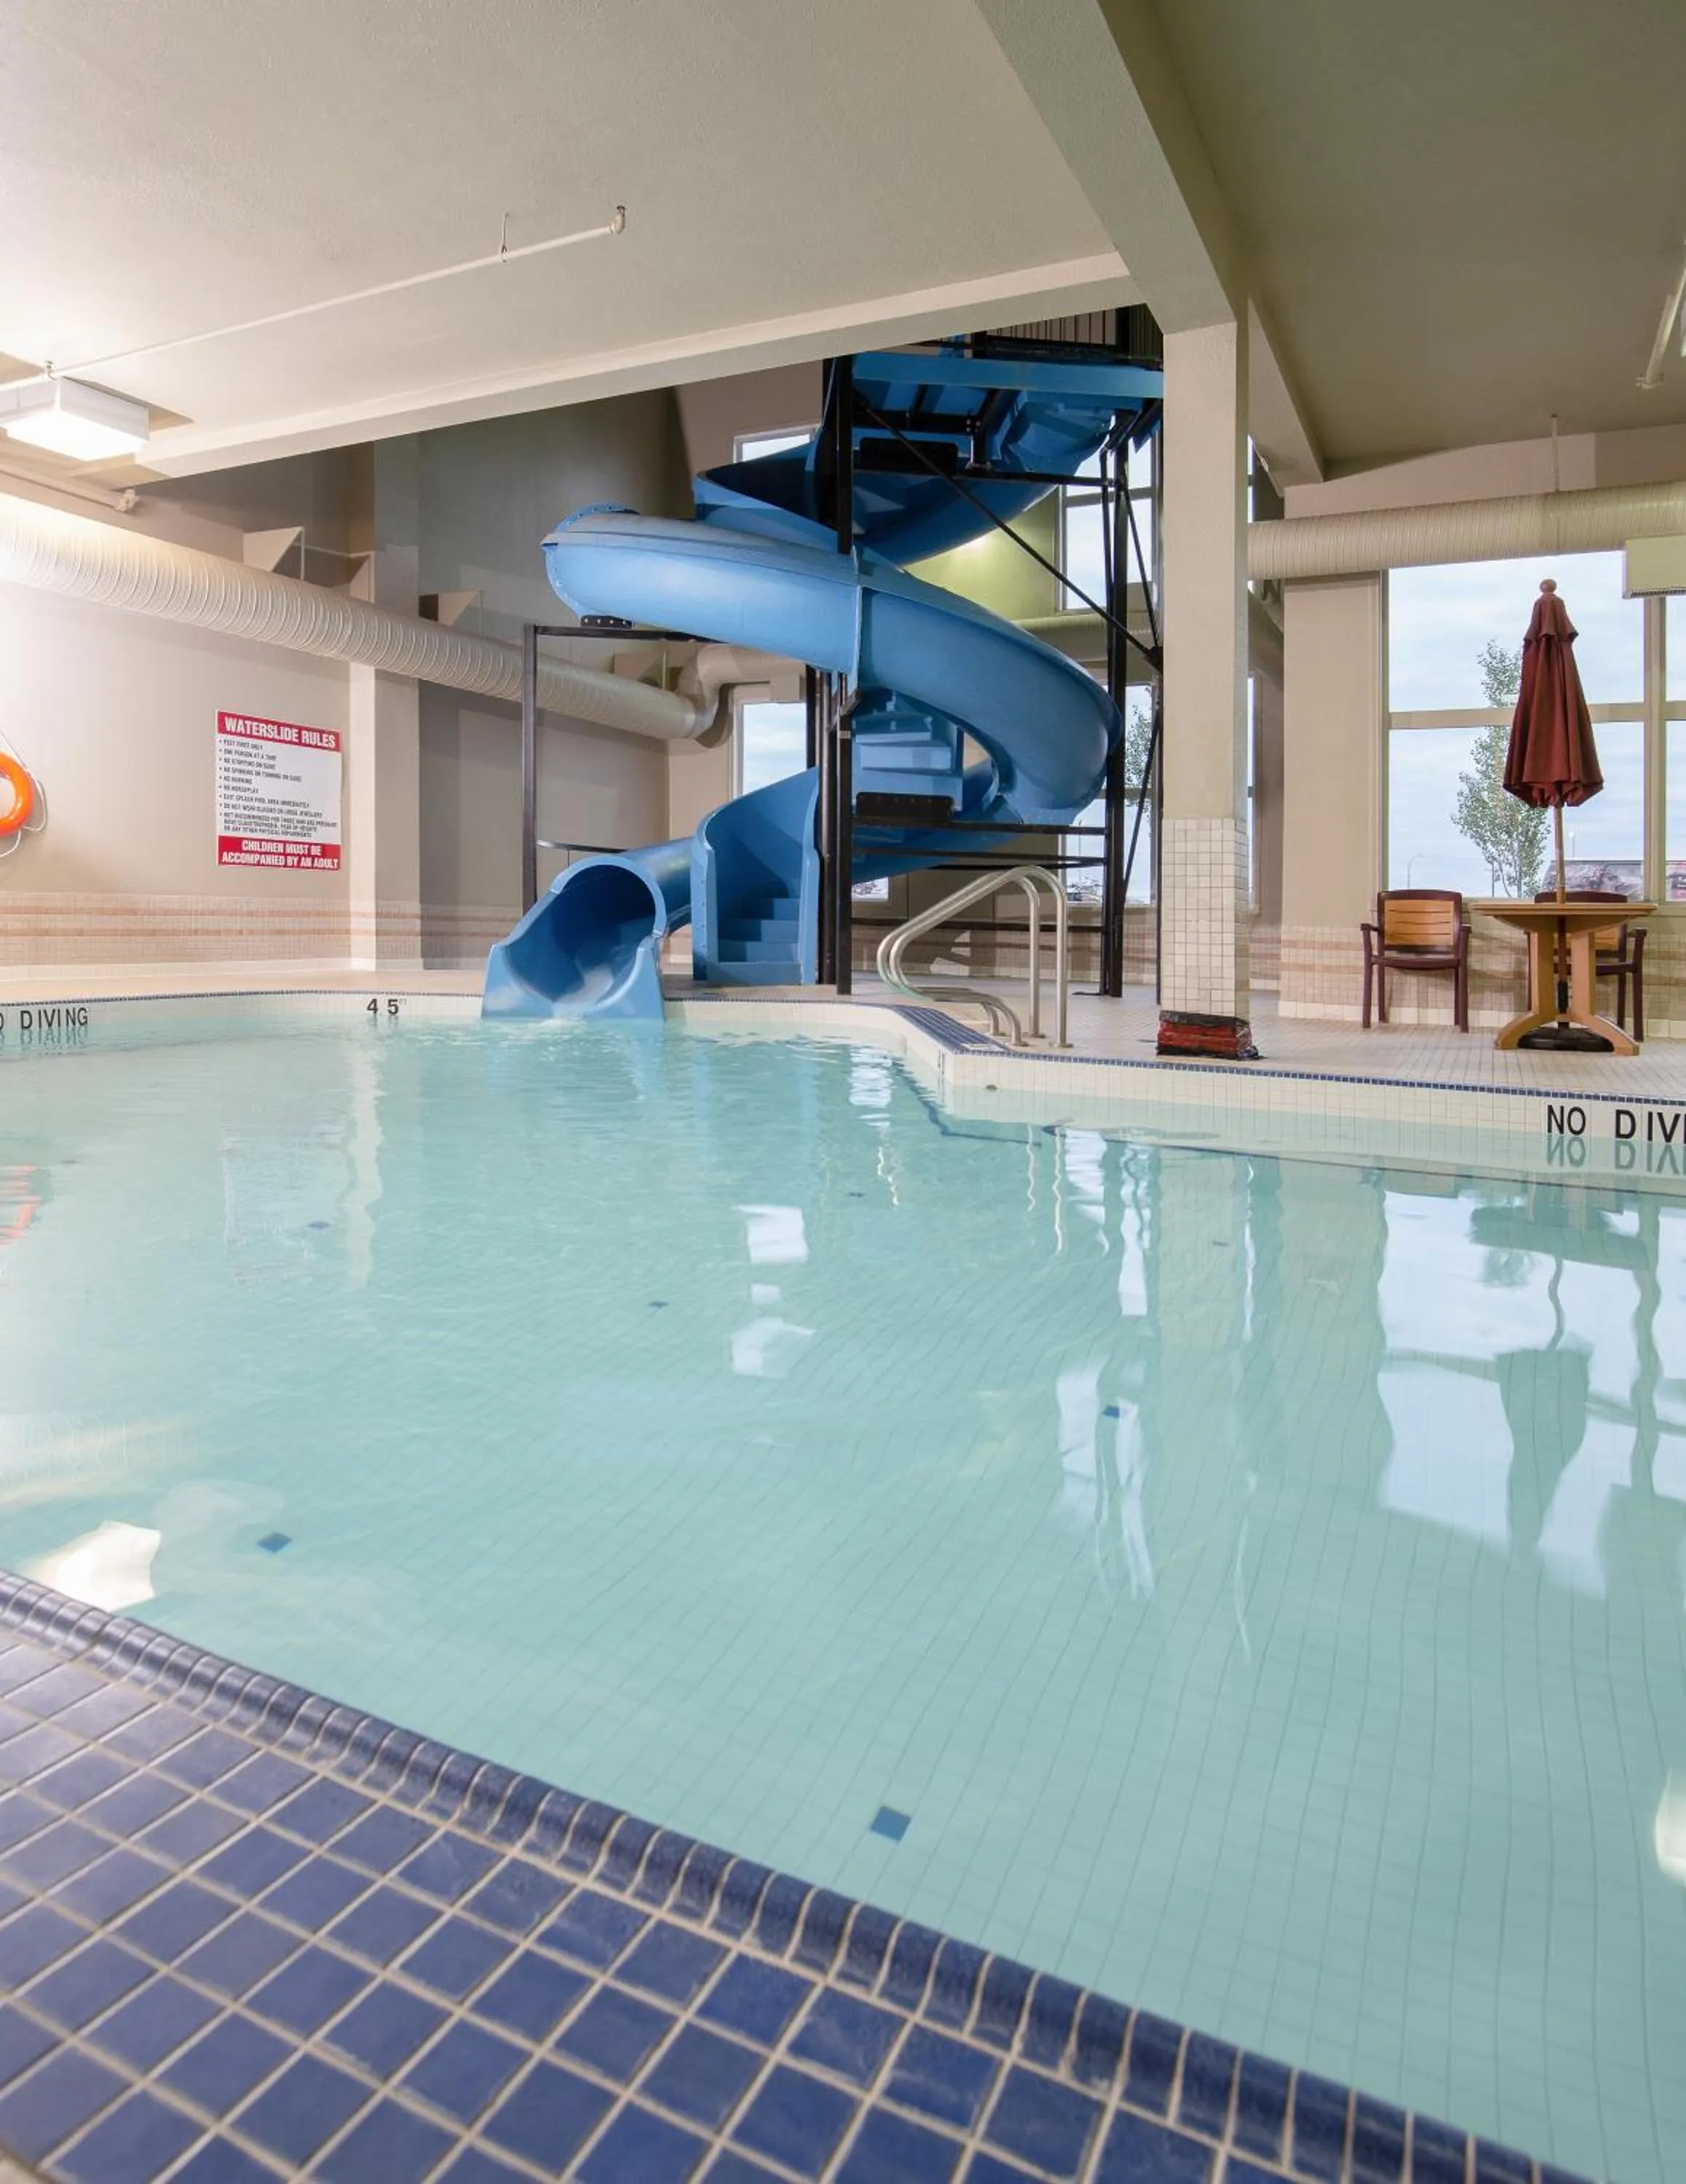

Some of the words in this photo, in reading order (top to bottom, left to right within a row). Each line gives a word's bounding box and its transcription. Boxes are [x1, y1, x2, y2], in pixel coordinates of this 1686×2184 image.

[225, 716, 299, 742] WATERSLIDE
[301, 730, 336, 748] RULES
[242, 839, 284, 853] CHILDREN
[285, 843, 309, 855] MUST
[311, 844, 322, 856] BE
[222, 851, 285, 866] ACCOMPANIED
[287, 856, 298, 866] BY
[301, 857, 312, 867] AN
[313, 857, 338, 869] ADULT
[367, 998, 379, 1014] 4
[387, 998, 399, 1015] 5
[20, 1007, 88, 1029] DIVING
[1547, 1104, 1586, 1136] NO
